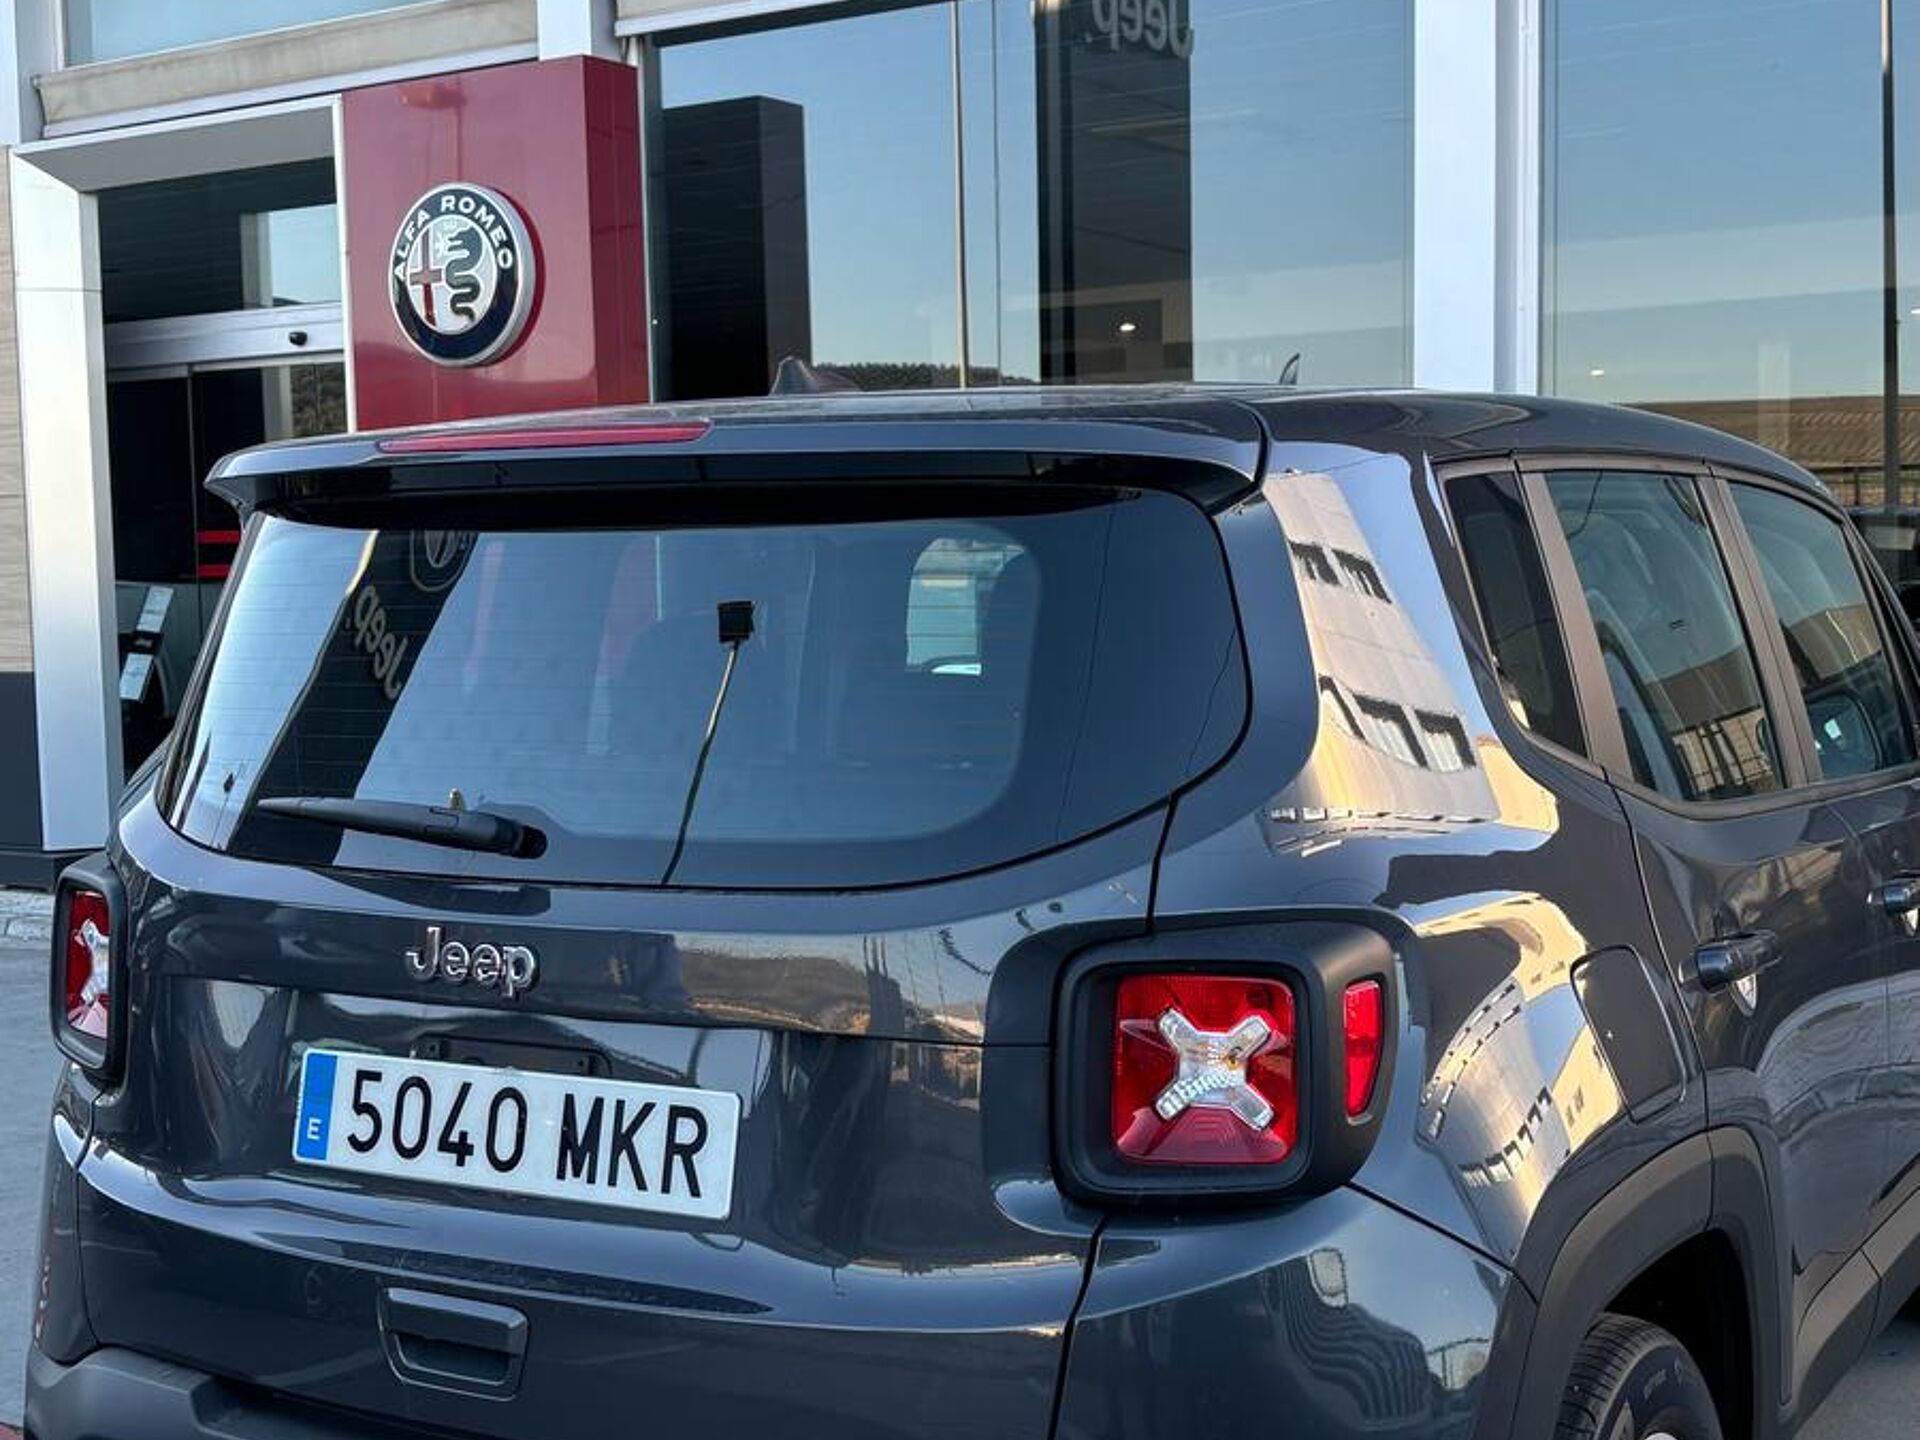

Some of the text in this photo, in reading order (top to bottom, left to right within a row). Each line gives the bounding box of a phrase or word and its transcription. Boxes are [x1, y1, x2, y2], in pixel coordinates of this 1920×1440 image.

[393, 195, 513, 281] ALFA ROMEO
[405, 926, 538, 998] Jeep
[306, 1118, 321, 1140] E
[346, 1069, 709, 1199] 5040 MKR
